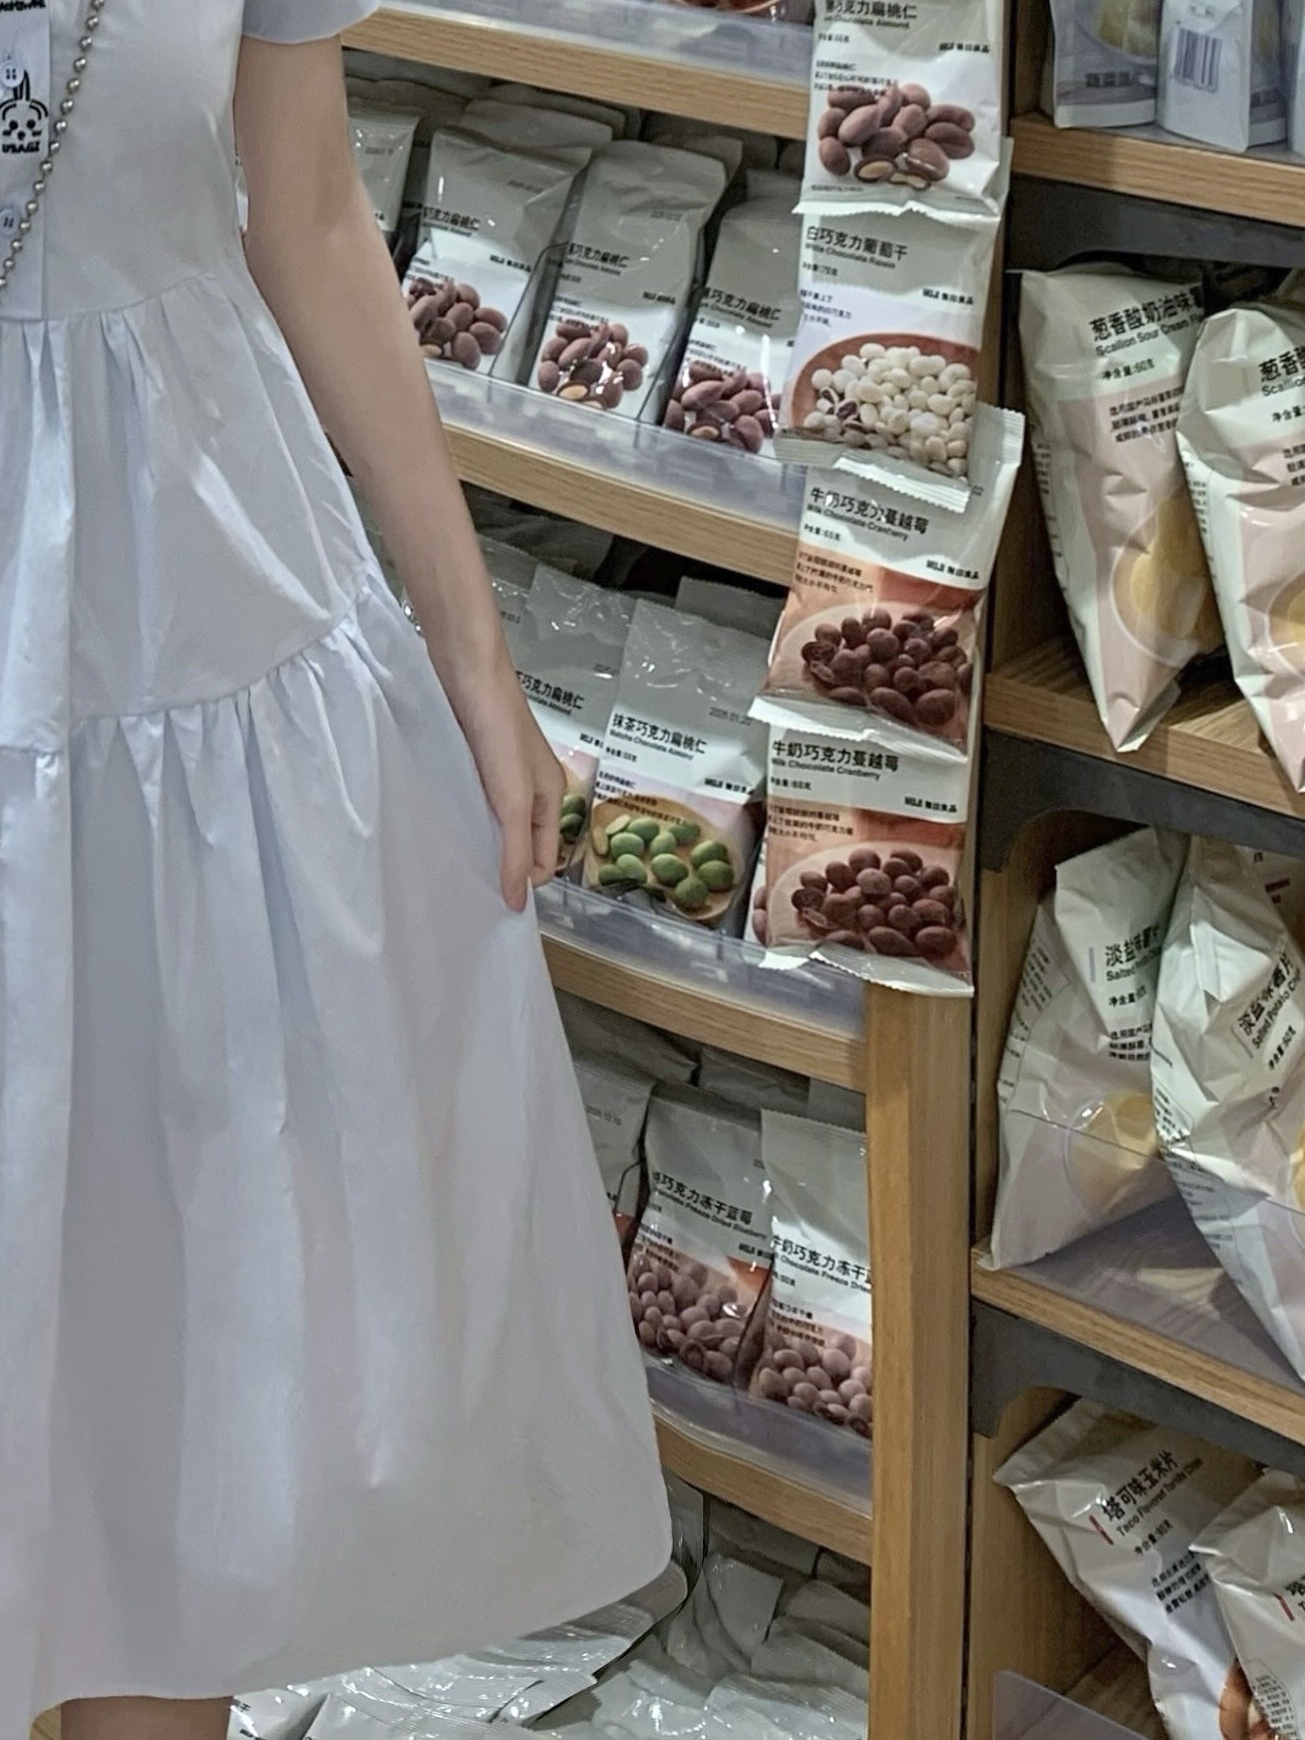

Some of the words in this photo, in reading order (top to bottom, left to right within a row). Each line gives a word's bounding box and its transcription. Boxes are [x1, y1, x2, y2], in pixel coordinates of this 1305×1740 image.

[807, 225, 908, 261] 白巧克力葡萄干
[1095, 336, 1137, 357] Scallion
[1138, 327, 1159, 342] Sour
[810, 487, 929, 535] 牛奶巧克力蔓越莓
[613, 713, 707, 754] 抹茶巧克力扁桃仁
[773, 740, 899, 772] 牛奶巧克力蔓越莓
[788, 760, 835, 773] Chocolate
[837, 766, 881, 781] Cranberry
